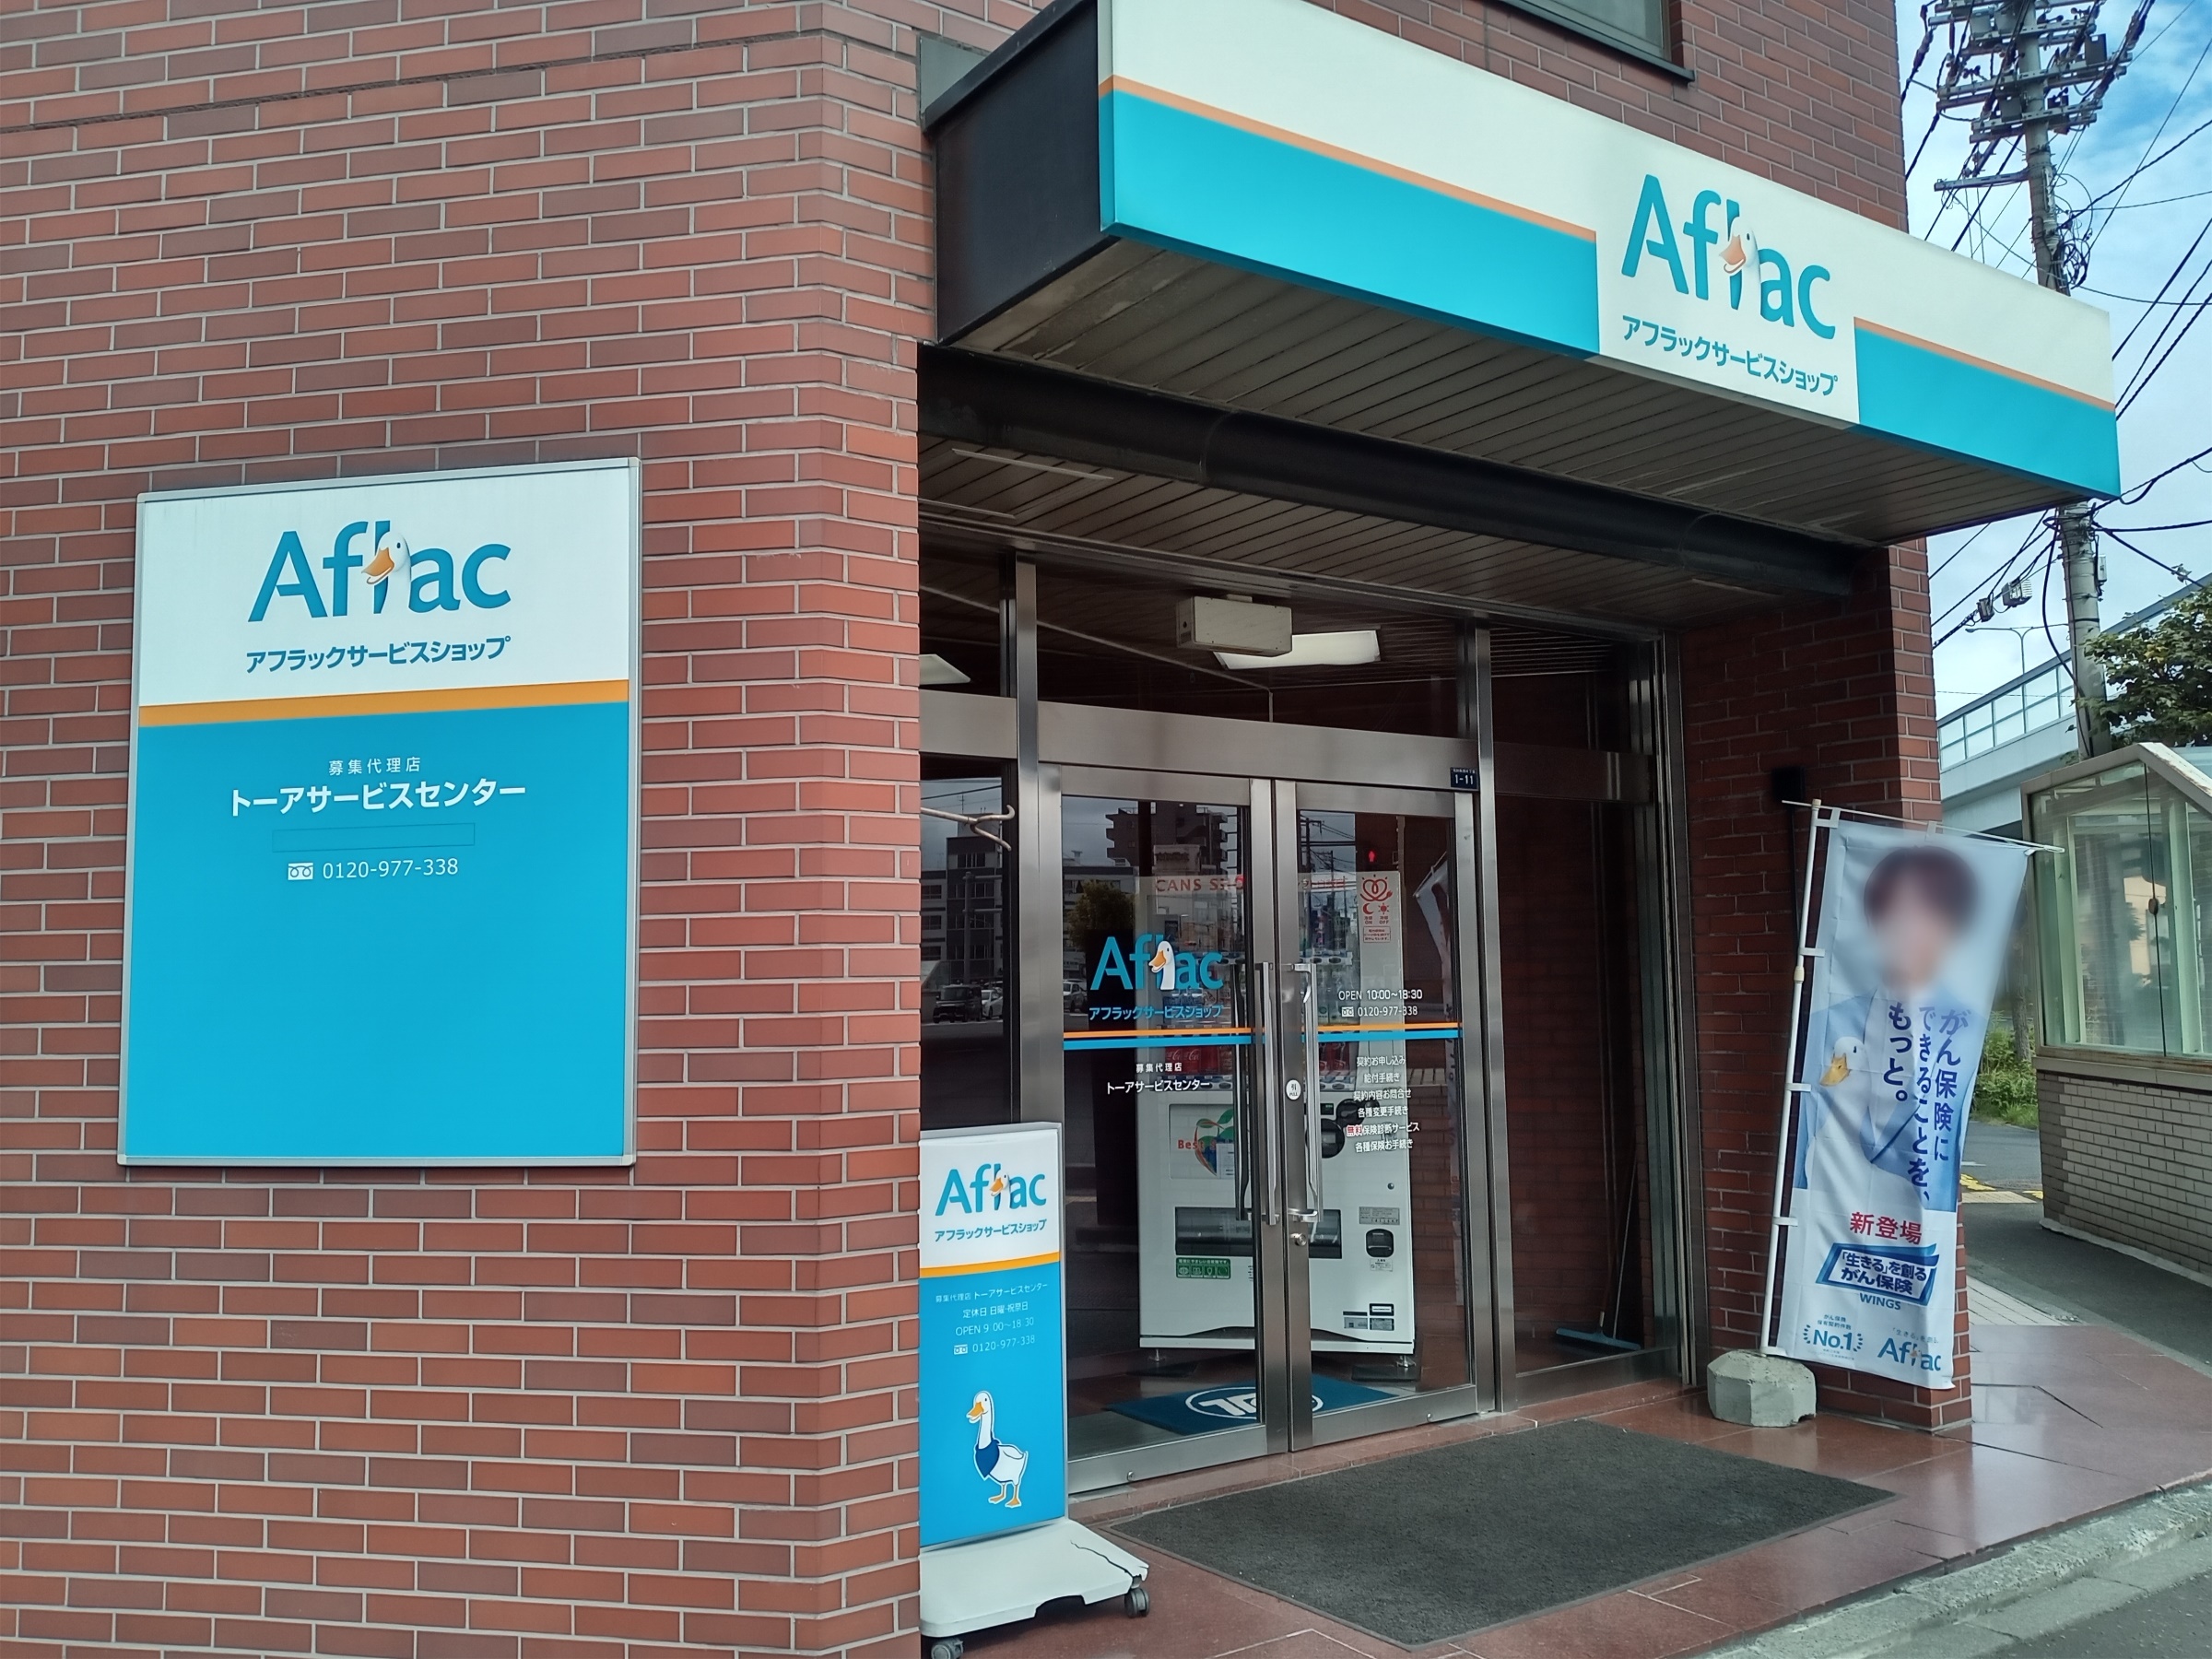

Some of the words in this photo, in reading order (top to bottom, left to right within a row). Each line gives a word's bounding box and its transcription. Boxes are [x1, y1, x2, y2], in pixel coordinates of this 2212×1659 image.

[1621, 174, 1835, 339] Aflac
[1622, 314, 1838, 395] アフラックサービスショップ
[247, 520, 512, 622] Aflac
[246, 636, 511, 674] アフラックサービスショップ
[328, 756, 422, 776] 募集代理店
[1454, 774, 1474, 785] 1-11
[231, 778, 526, 817] トーアサービスセンター
[323, 858, 459, 880] 0120-977-338
[1156, 878, 1202, 892] CANS
[1338, 990, 1362, 1000] OPEN
[1088, 1005, 1224, 1020] アフラックサービスショップ
[1357, 1006, 1418, 1017] 0120-977-338
[1883, 1002, 1912, 1102] もっと。
[1135, 1063, 1182, 1074] 募集代理店
[1107, 1078, 1210, 1095] トーアサービスセンター
[1935, 1008, 1971, 1161] がん保険に
[935, 1163, 1047, 1216] Aflac
[935, 1218, 1047, 1242] アフラックサービスショップ
[1850, 1211, 1922, 1245] 新登場
[974, 1282, 1048, 1300] トーアサービスセンター
[1841, 1267, 1913, 1295] がん保険
[1859, 1292, 1901, 1311] WINGS
[955, 1324, 981, 1336] OPEN
[1813, 1329, 1853, 1351] No.1
[972, 1335, 1036, 1353] 0120-977-338
[1877, 1337, 1942, 1371] Aflac
